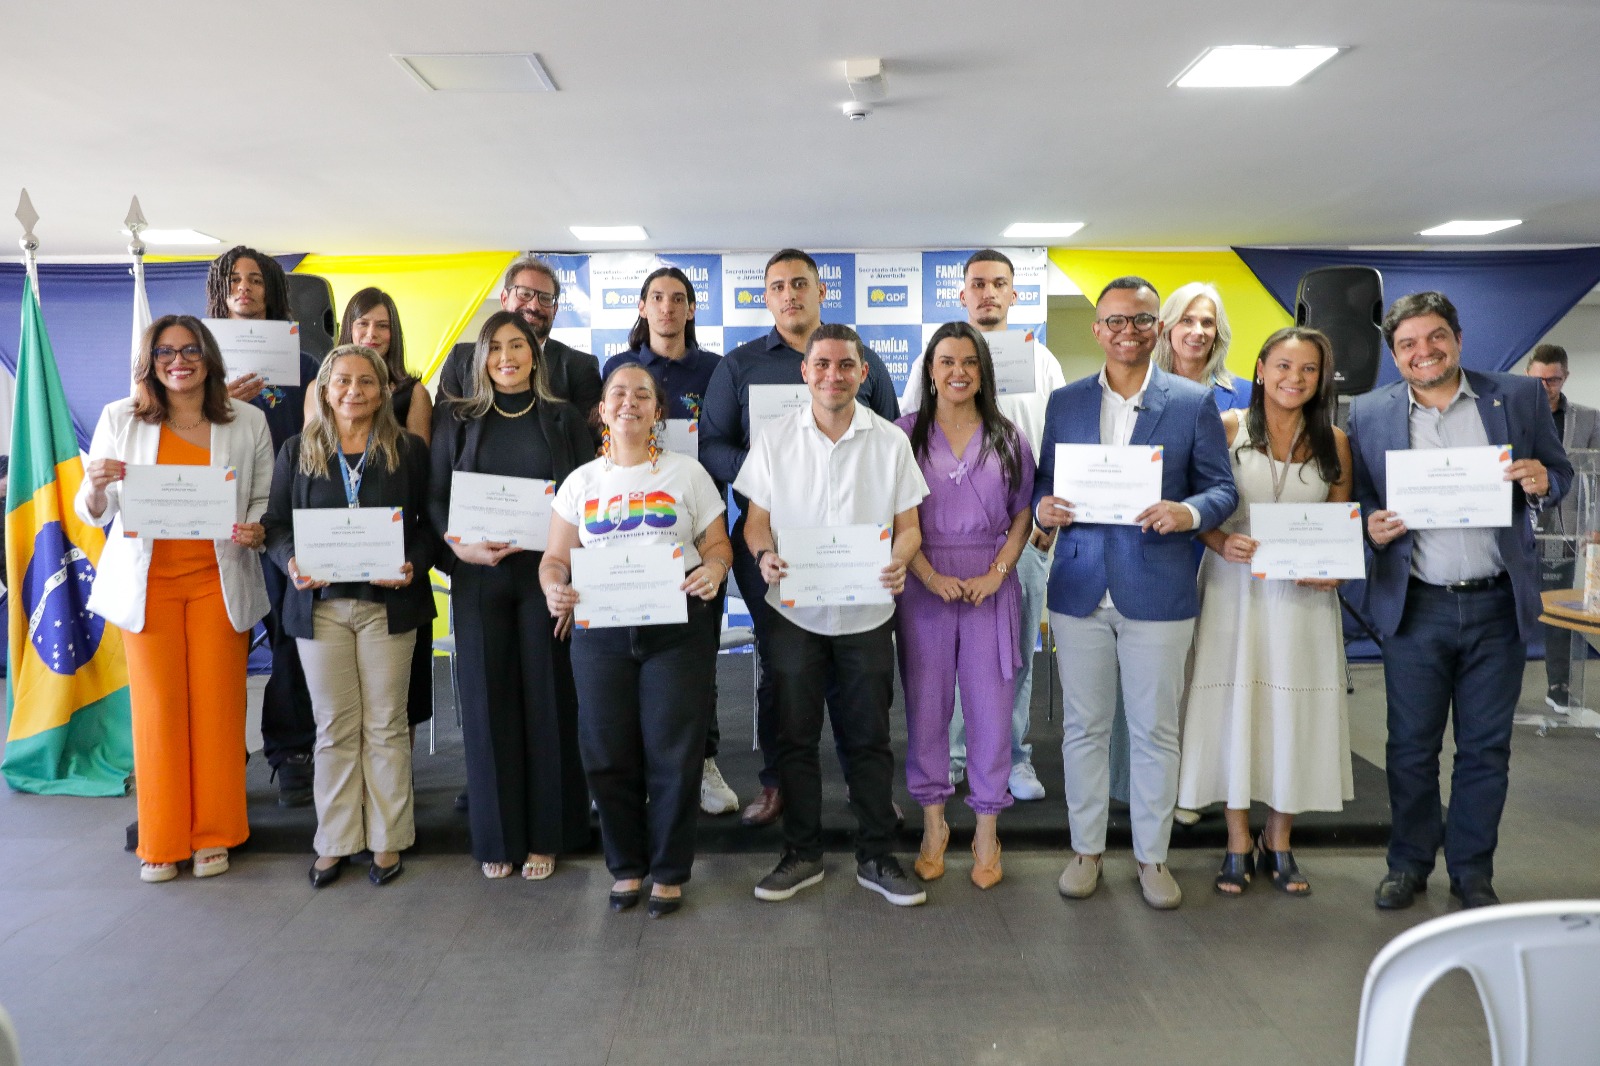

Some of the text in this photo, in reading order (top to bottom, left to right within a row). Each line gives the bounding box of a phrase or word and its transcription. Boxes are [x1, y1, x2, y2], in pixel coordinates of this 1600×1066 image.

[681, 265, 709, 281] MÍLIA
[817, 263, 842, 280] MÍLIA
[935, 262, 964, 279] FAMÍL
[886, 292, 906, 303] GDF
[1018, 291, 1039, 302] GDF
[869, 336, 909, 353] FAMÍLIA
[584, 490, 678, 535] UJS
